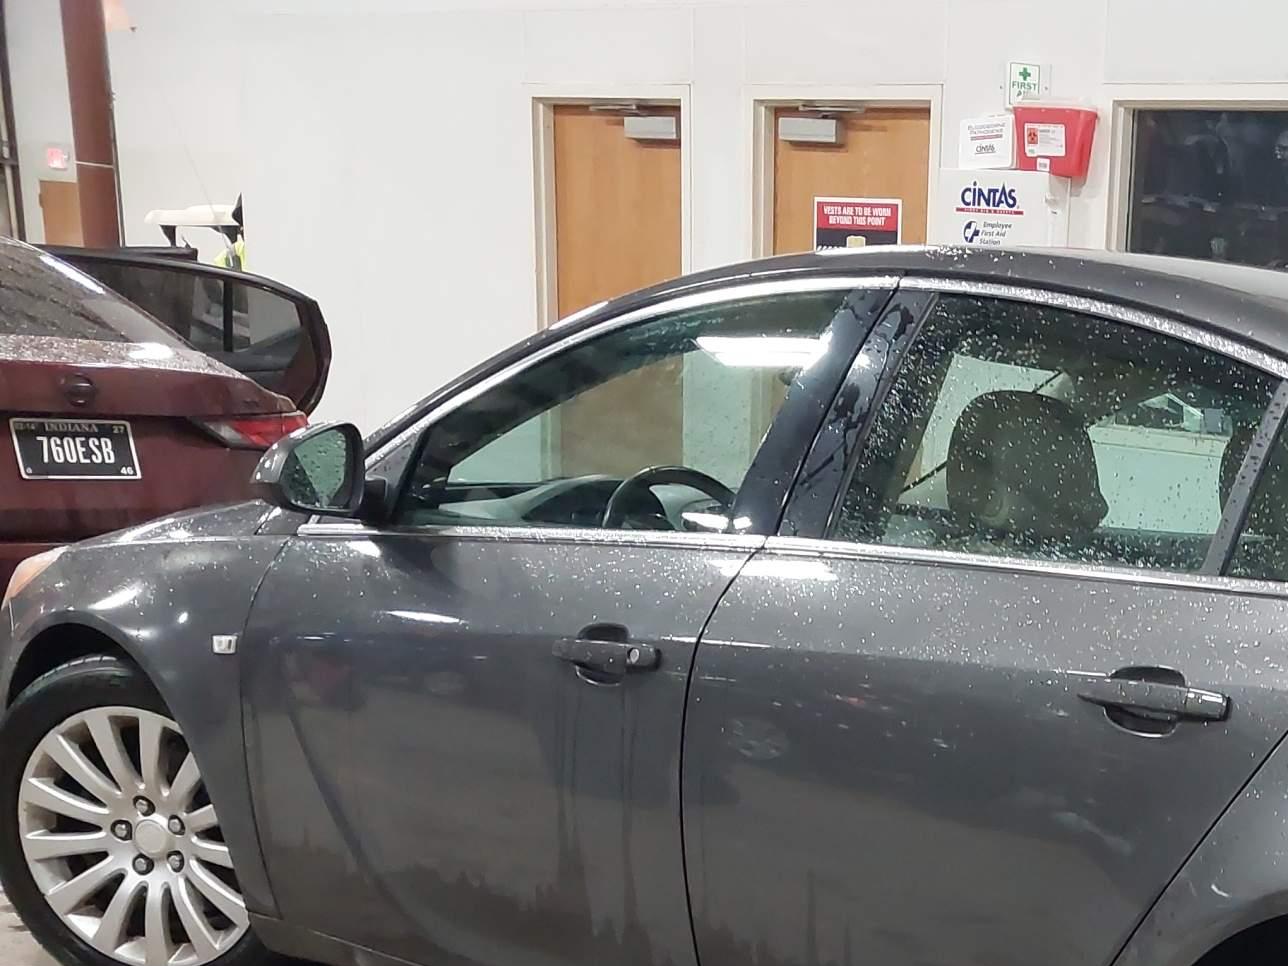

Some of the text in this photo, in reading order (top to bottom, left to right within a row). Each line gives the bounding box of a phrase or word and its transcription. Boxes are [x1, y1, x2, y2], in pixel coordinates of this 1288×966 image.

[1012, 81, 1037, 91] FIRST
[961, 181, 1017, 208] CINTAS
[823, 205, 891, 217] VESTS ARE TO BE WORN
[829, 215, 886, 225] BEYOND THIS POINT
[983, 221, 1013, 230] Employee
[981, 230, 1007, 238] First Aid
[979, 238, 1001, 246] Station
[44, 422, 98, 433] INDIANA
[112, 426, 125, 434] 27
[36, 436, 116, 464] 760ESB
[120, 466, 134, 475] 46
